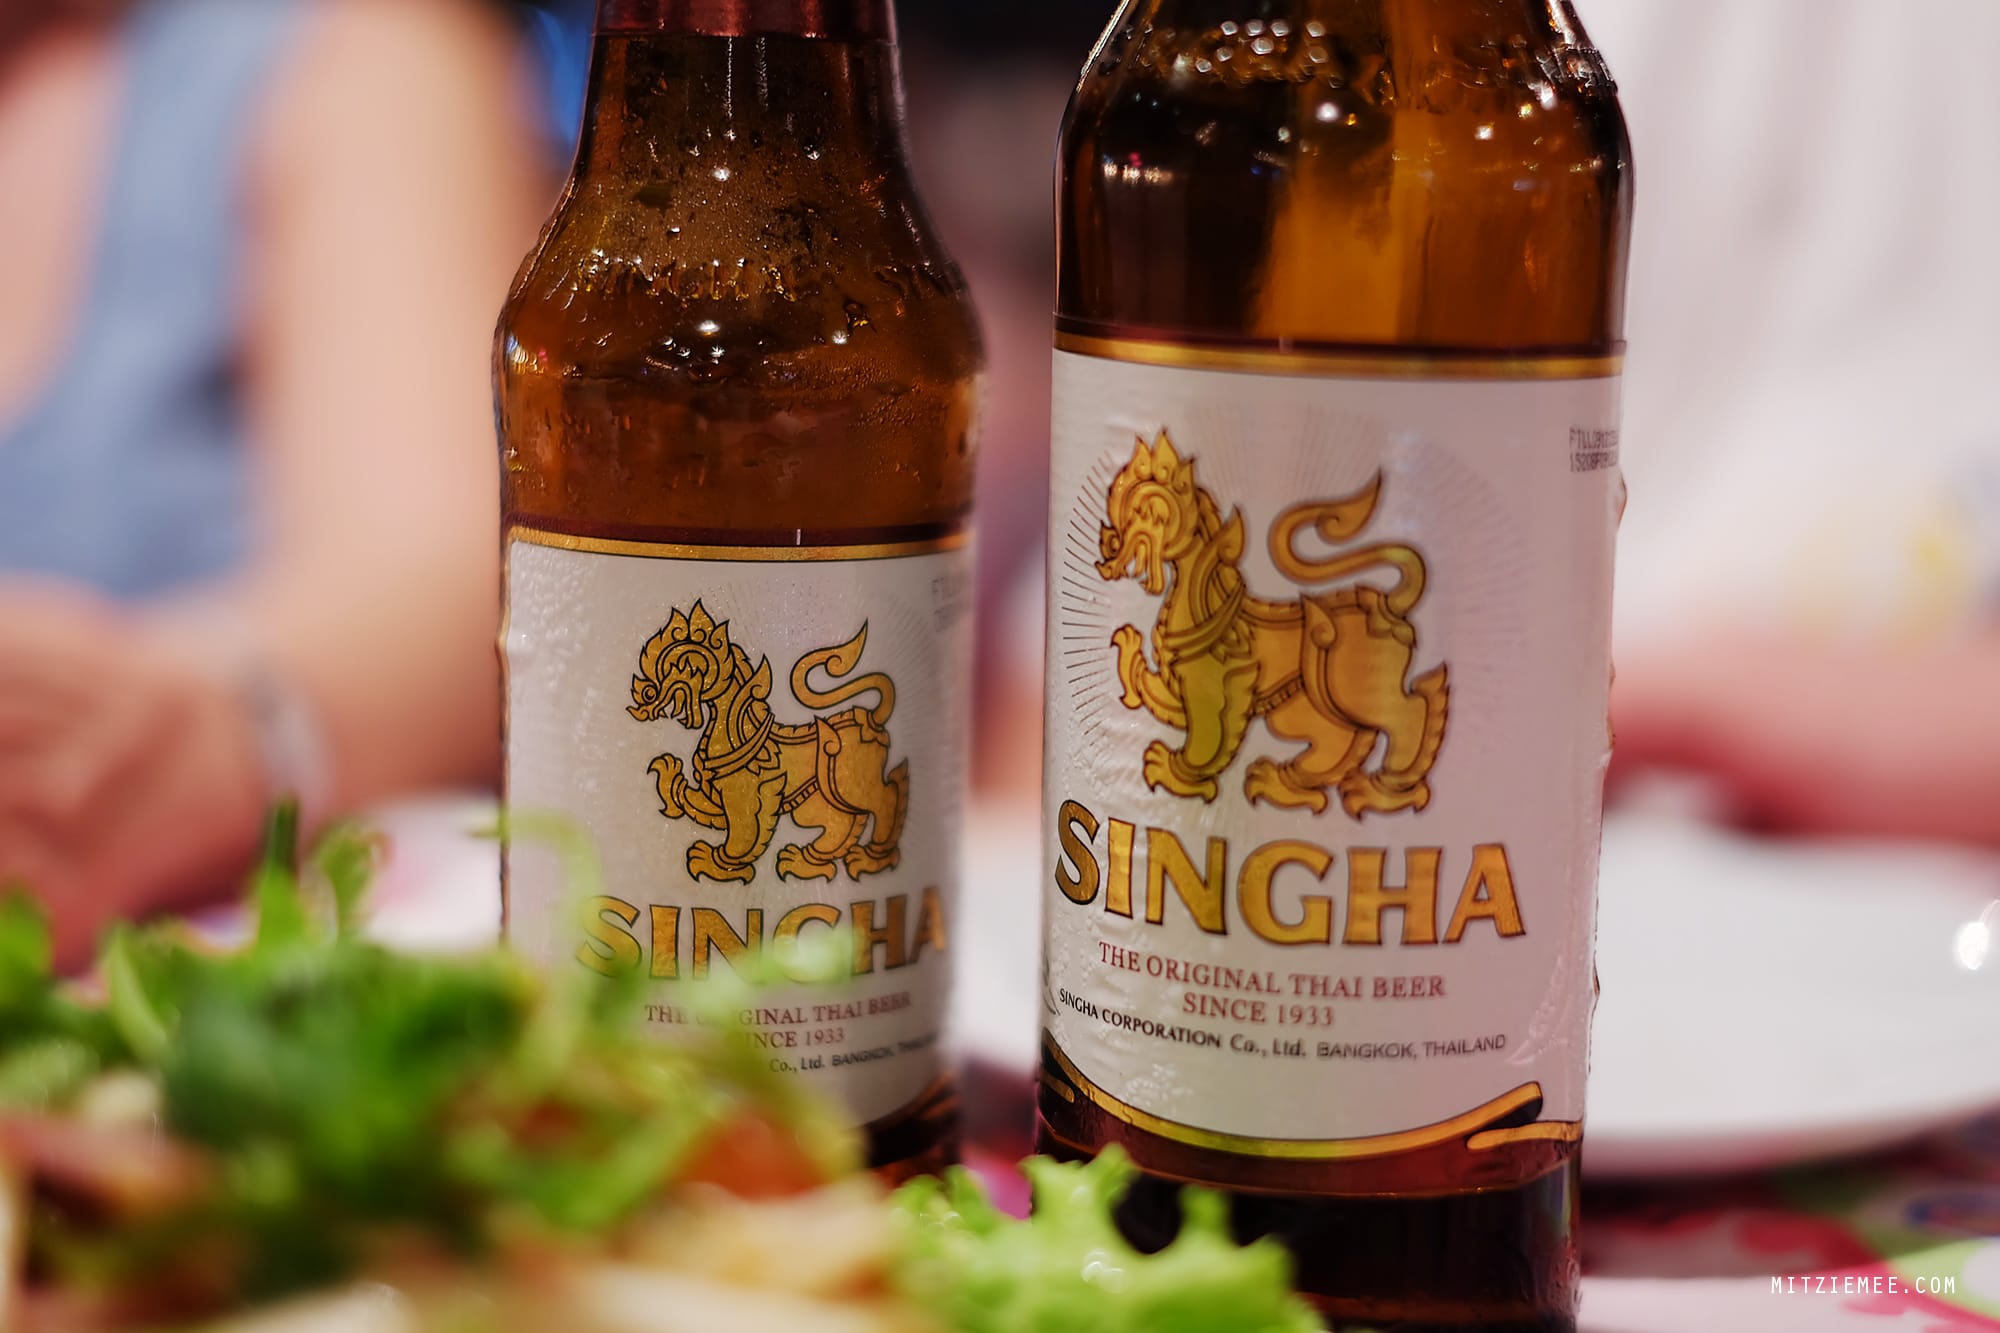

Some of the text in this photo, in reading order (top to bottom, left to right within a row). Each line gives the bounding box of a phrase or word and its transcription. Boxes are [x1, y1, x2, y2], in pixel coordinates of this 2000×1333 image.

[1054, 799, 1527, 946] SINGHA
[575, 885, 946, 984] SINGHA
[1098, 941, 1447, 999] THE ORIGINAL THAI BEER
[813, 1001, 863, 1023] THAI
[868, 991, 911, 1016] BEER
[1058, 988, 1099, 1020] SINGHA
[1102, 1008, 1221, 1049] CORPORATION
[1272, 1038, 1307, 1057] Ltd.
[1316, 1041, 1418, 1061] BANGKOK,
[1421, 1034, 1507, 1057] THAILAND
[1182, 991, 1335, 1026] SINCE 1933
[805, 1027, 845, 1047] 1933
[801, 1054, 825, 1071] Ltd.
